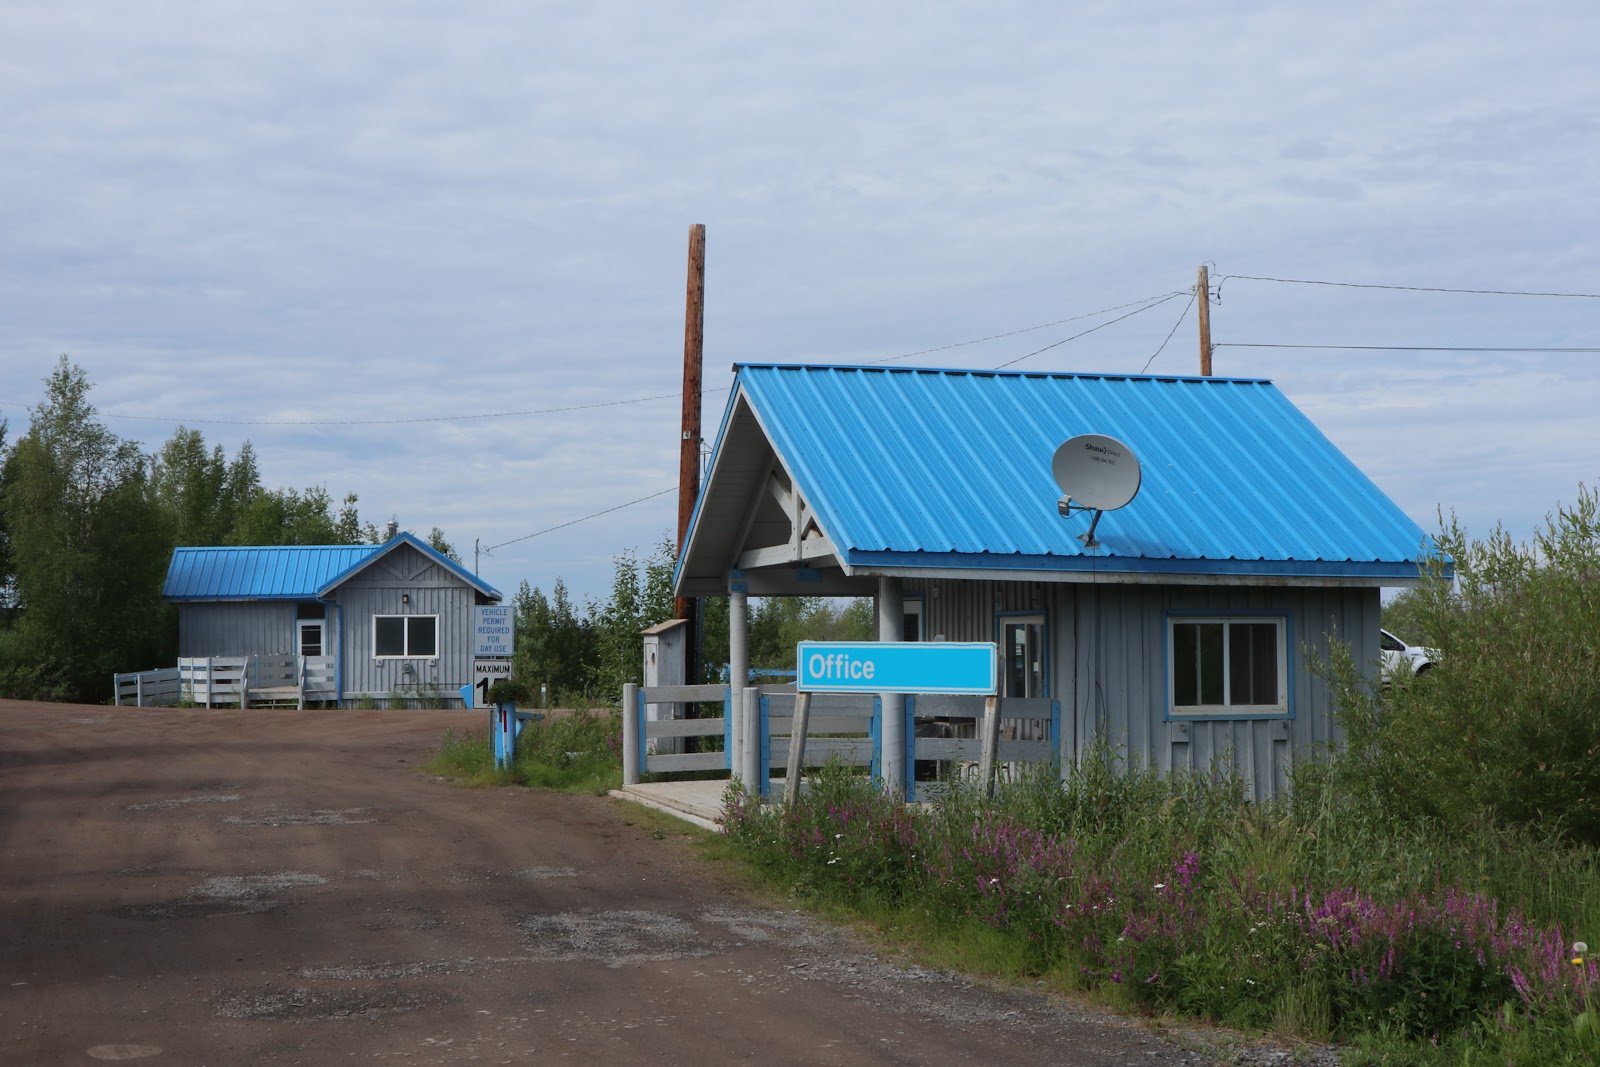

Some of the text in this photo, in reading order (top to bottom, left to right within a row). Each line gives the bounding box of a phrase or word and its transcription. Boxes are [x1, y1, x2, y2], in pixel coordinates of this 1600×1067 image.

[481, 608, 508, 616] VEHICLE
[476, 665, 510, 674] MAXIMUM
[809, 653, 875, 679] Office
